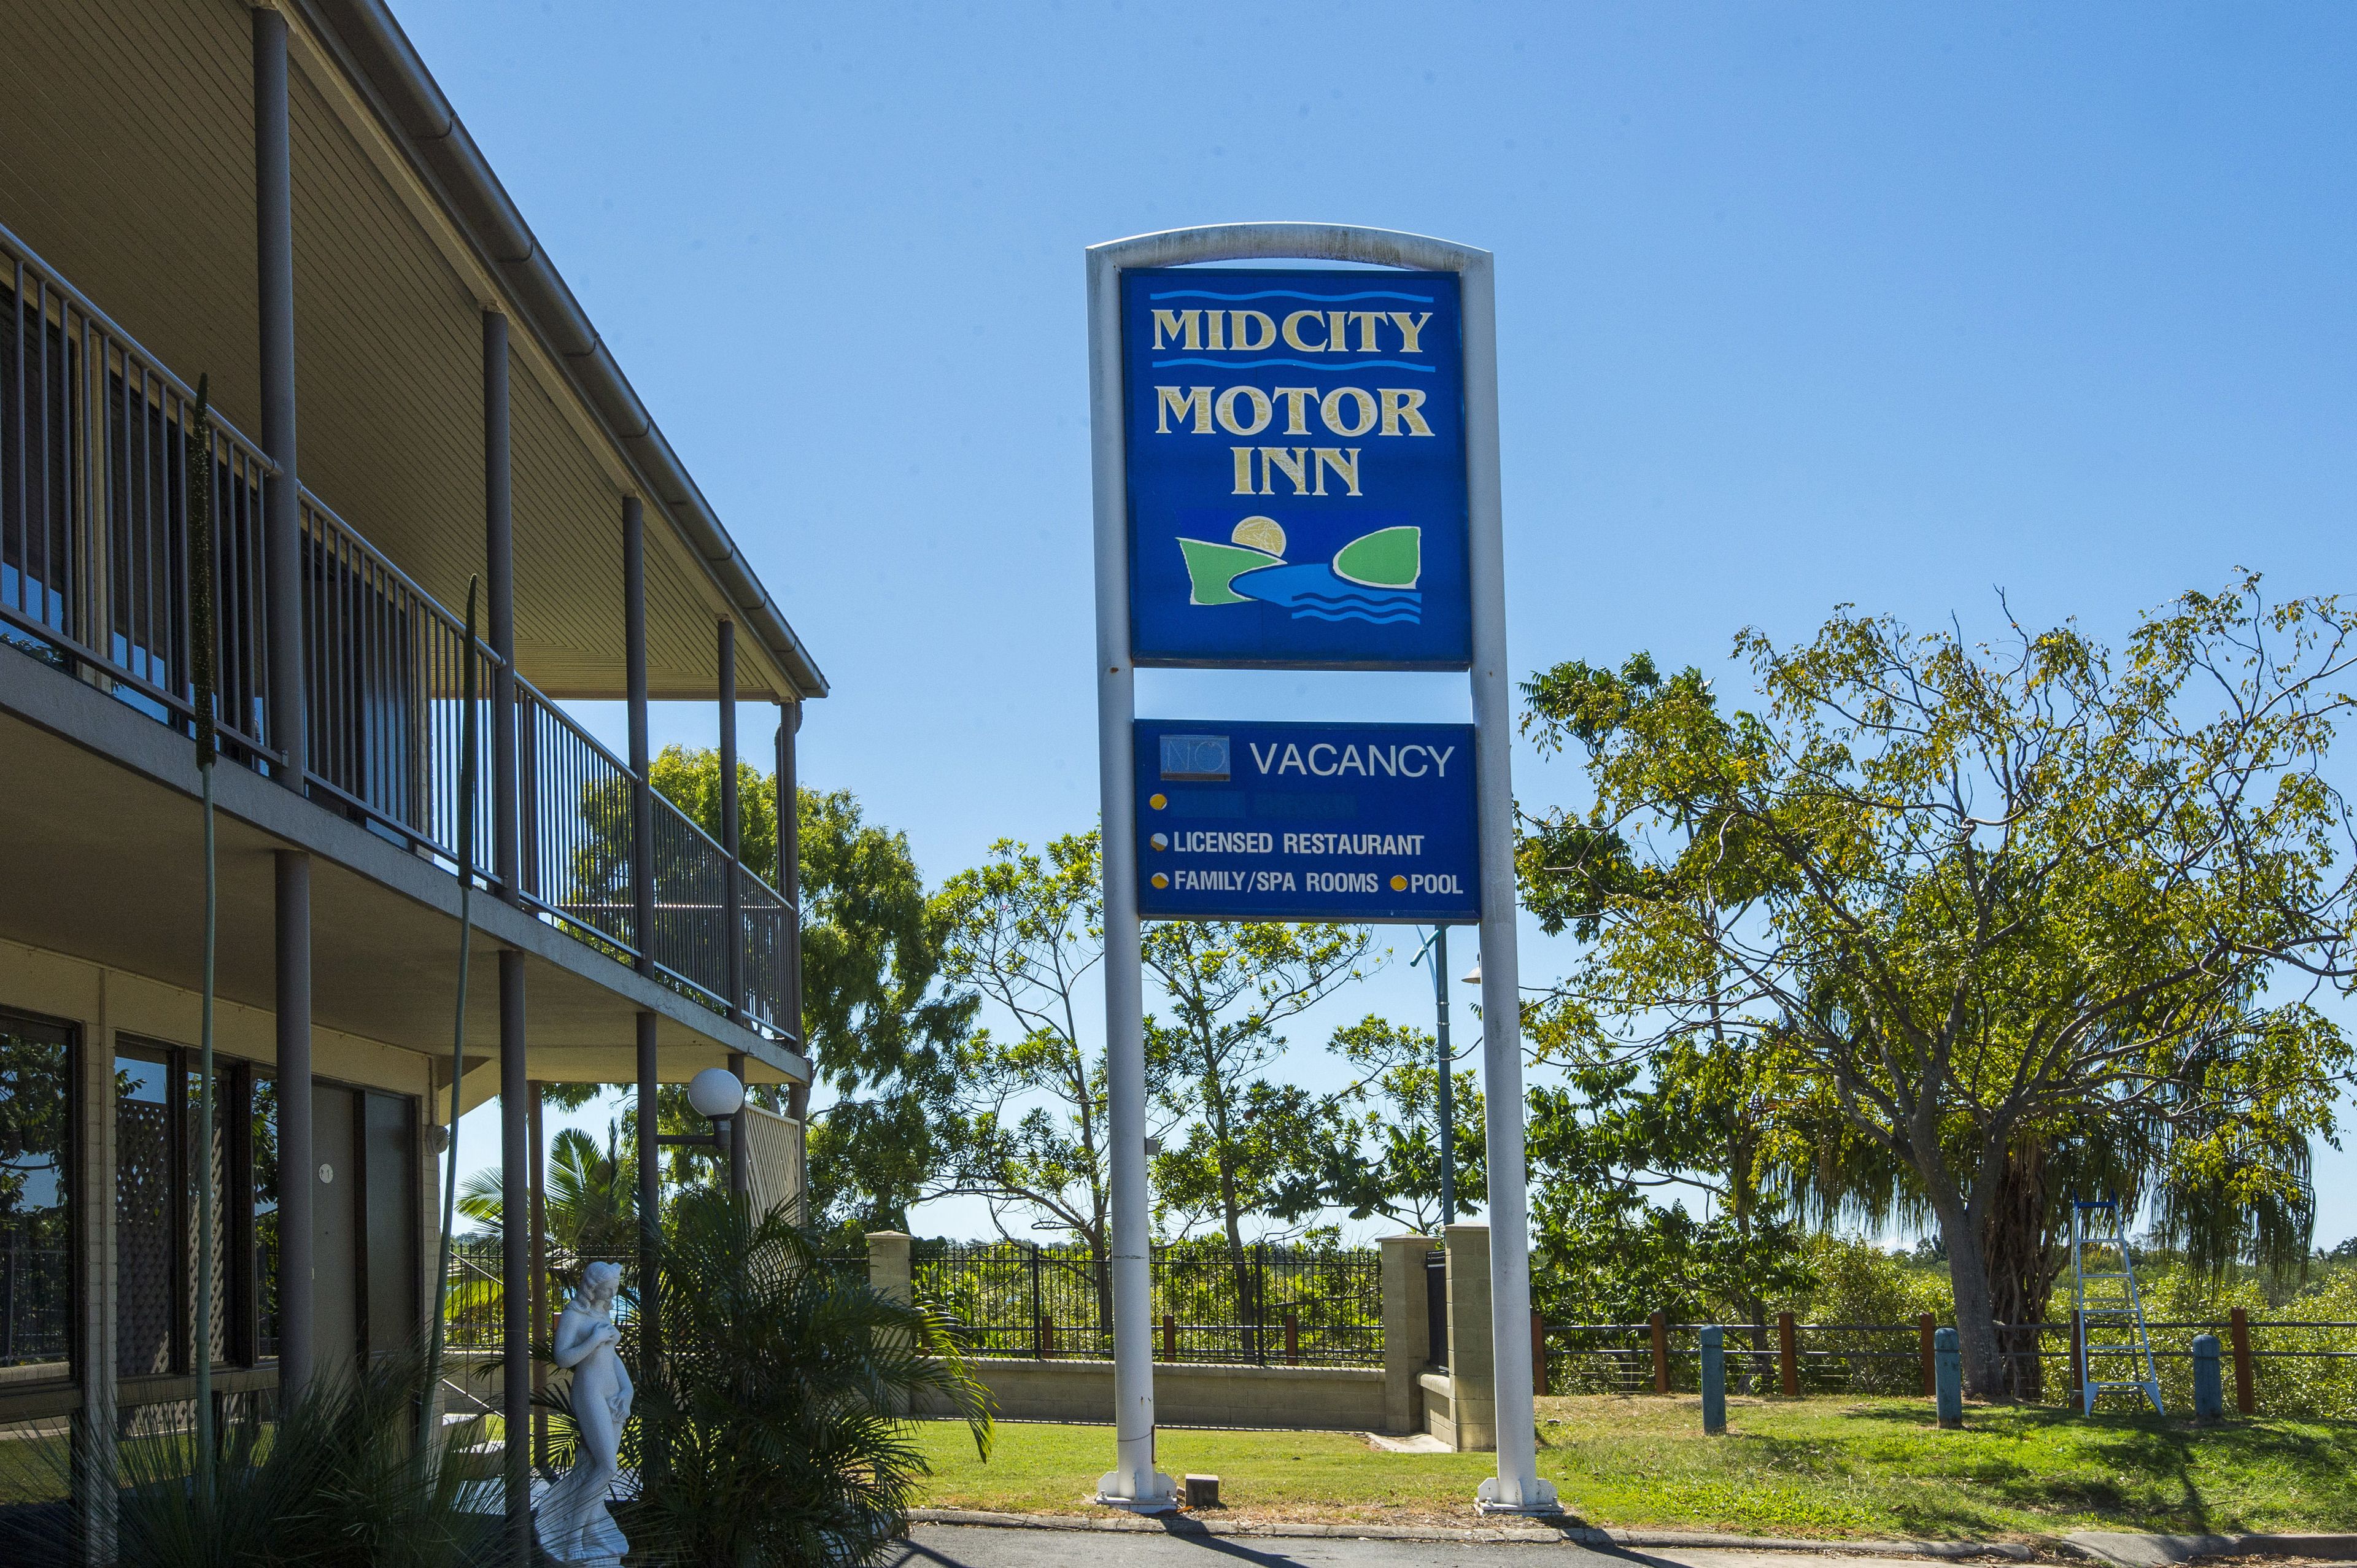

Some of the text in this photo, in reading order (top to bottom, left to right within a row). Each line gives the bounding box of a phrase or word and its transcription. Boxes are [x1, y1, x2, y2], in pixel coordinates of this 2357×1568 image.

[1154, 385, 1436, 437] MOTOR
[1229, 446, 1363, 496] INN
[1167, 740, 1455, 777] NO VACANCY
[1174, 832, 1425, 855] LICENSED RESTAURANT
[1175, 871, 1463, 894] FAMILY/SPA ROOMS POOL
